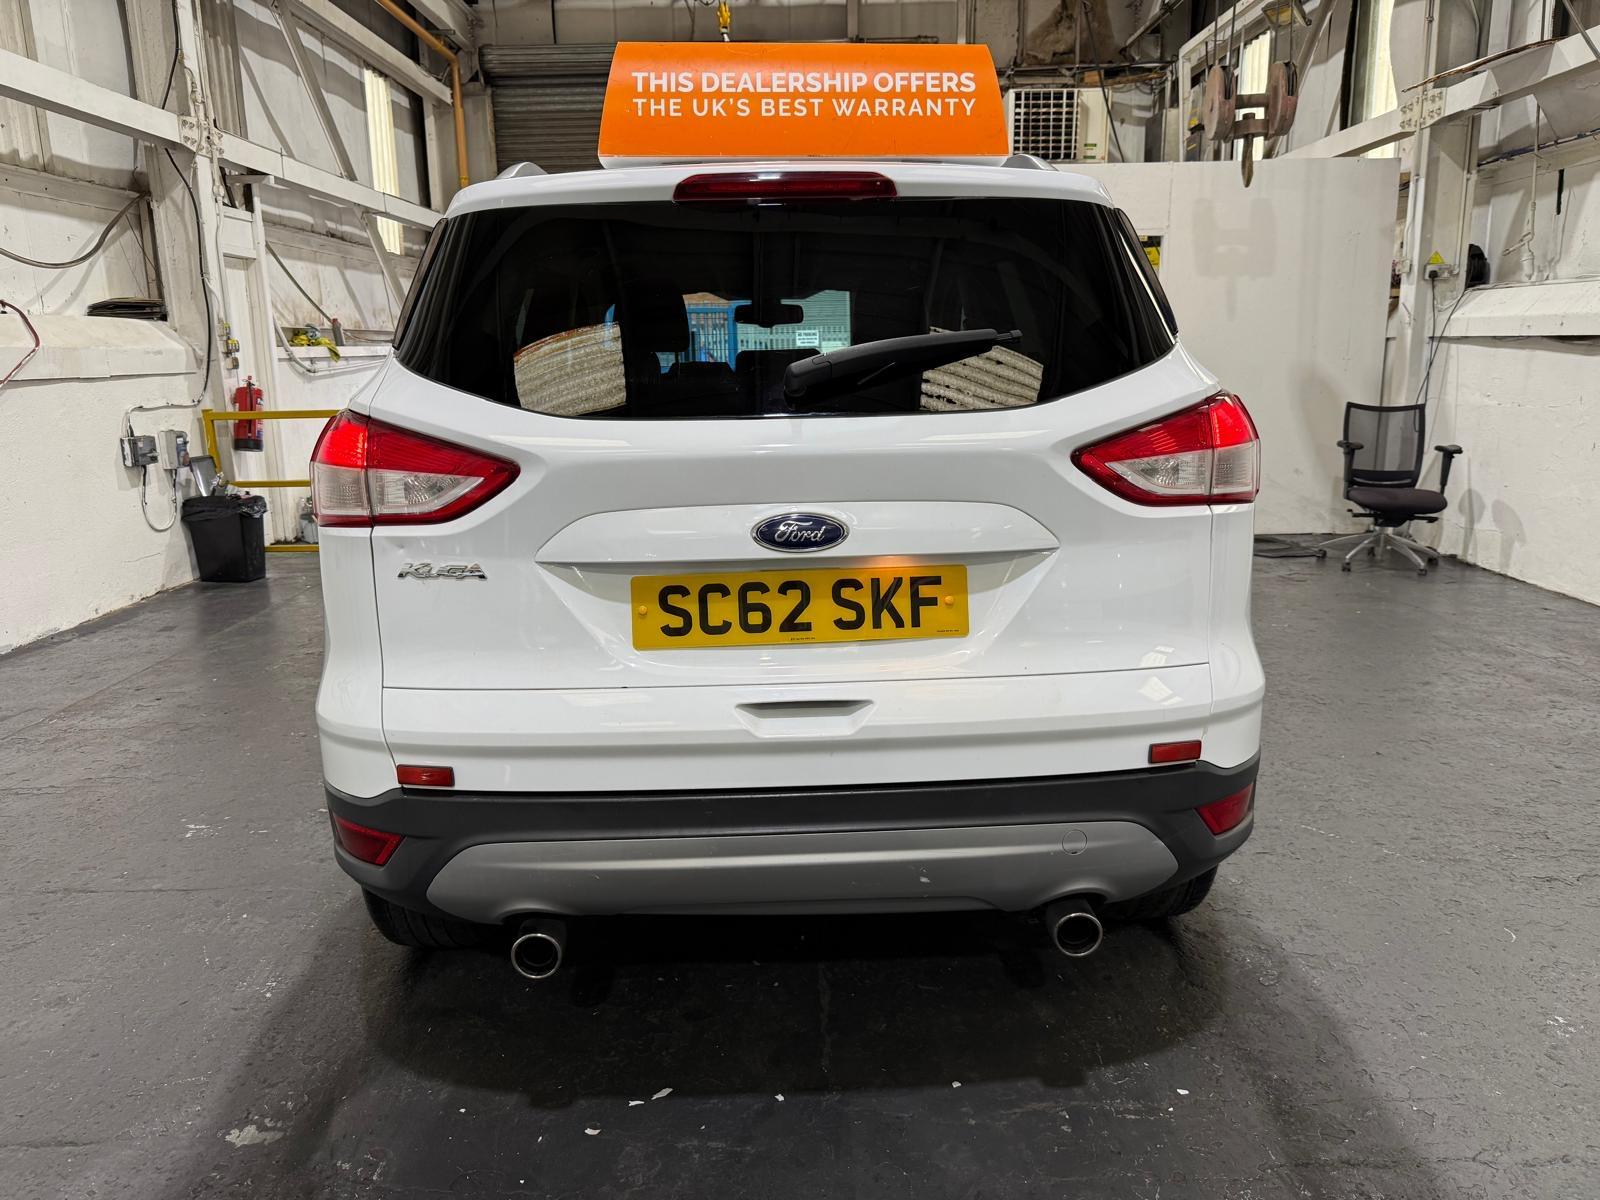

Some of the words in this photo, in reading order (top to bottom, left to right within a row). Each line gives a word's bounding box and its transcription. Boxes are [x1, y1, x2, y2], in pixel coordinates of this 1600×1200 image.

[632, 72, 693, 92] THIS
[702, 71, 867, 92] DEALERSHIP
[874, 72, 975, 92] OFFERS
[634, 99, 681, 115] THE
[762, 99, 822, 116] BEST
[833, 99, 974, 115] WARRANTY
[774, 520, 826, 542] Ford
[397, 562, 488, 580] KUGA
[658, 580, 812, 637] SC62
[832, 576, 941, 630] SKF
